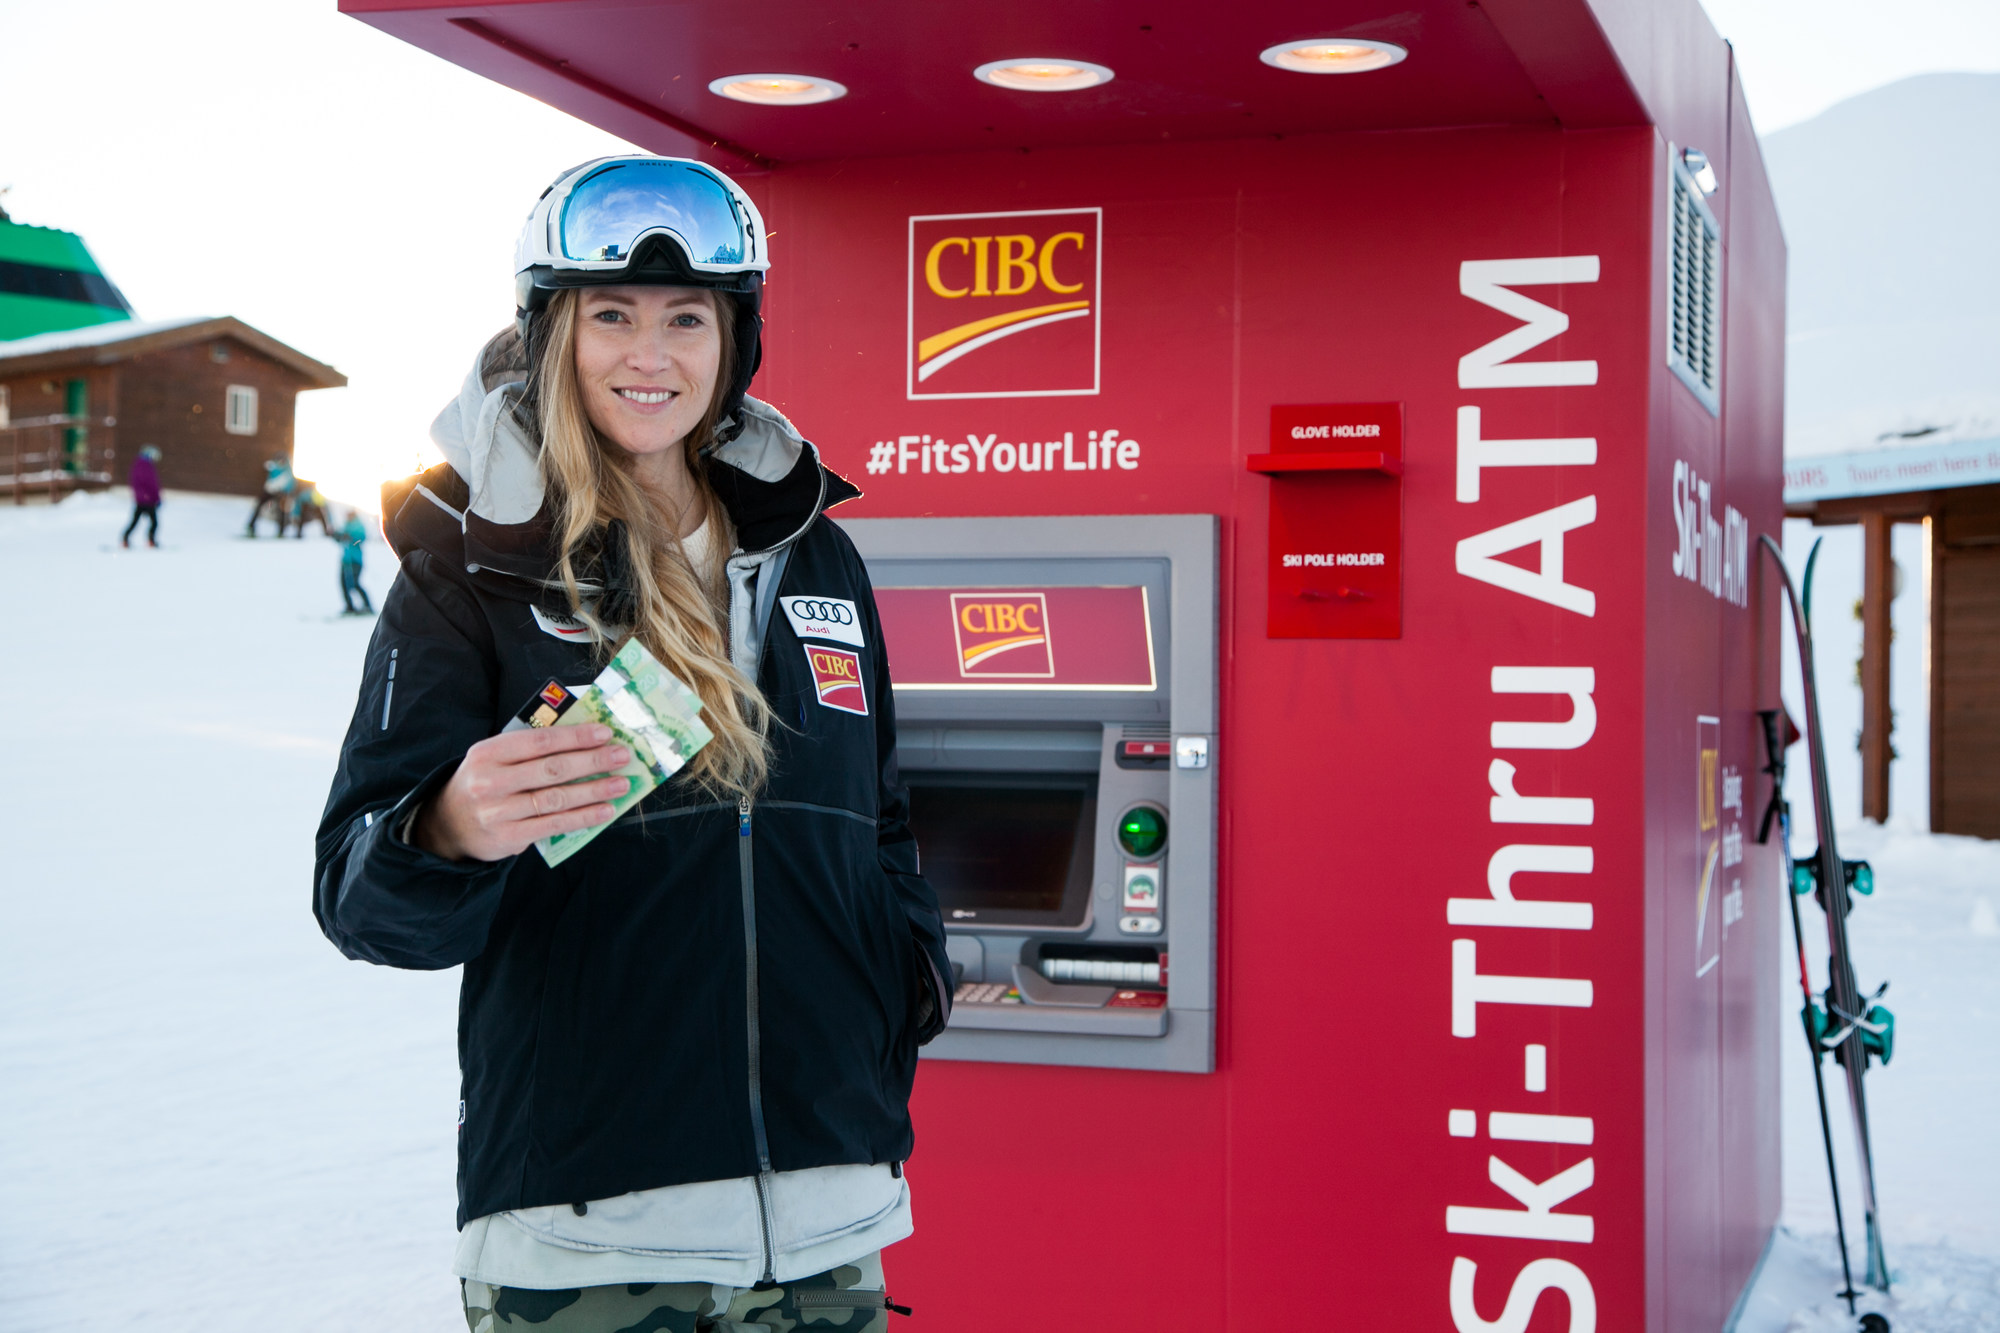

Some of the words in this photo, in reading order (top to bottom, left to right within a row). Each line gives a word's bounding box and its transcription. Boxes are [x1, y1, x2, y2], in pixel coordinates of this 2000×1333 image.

[925, 232, 1084, 299] CIBC
[1291, 426, 1330, 439] GLOVE
[1332, 424, 1380, 437] HOLDER
[1455, 255, 1600, 618] ATM
[866, 429, 1140, 474] #FitsYourLife
[1282, 554, 1302, 567] SKI
[1304, 554, 1335, 566] POLE
[1336, 553, 1385, 566] HOLDER
[806, 625, 831, 635] Audi
[961, 603, 1041, 633] CIBC
[813, 653, 857, 679] CIBC
[1446, 666, 1598, 1333] Ski-Thru
